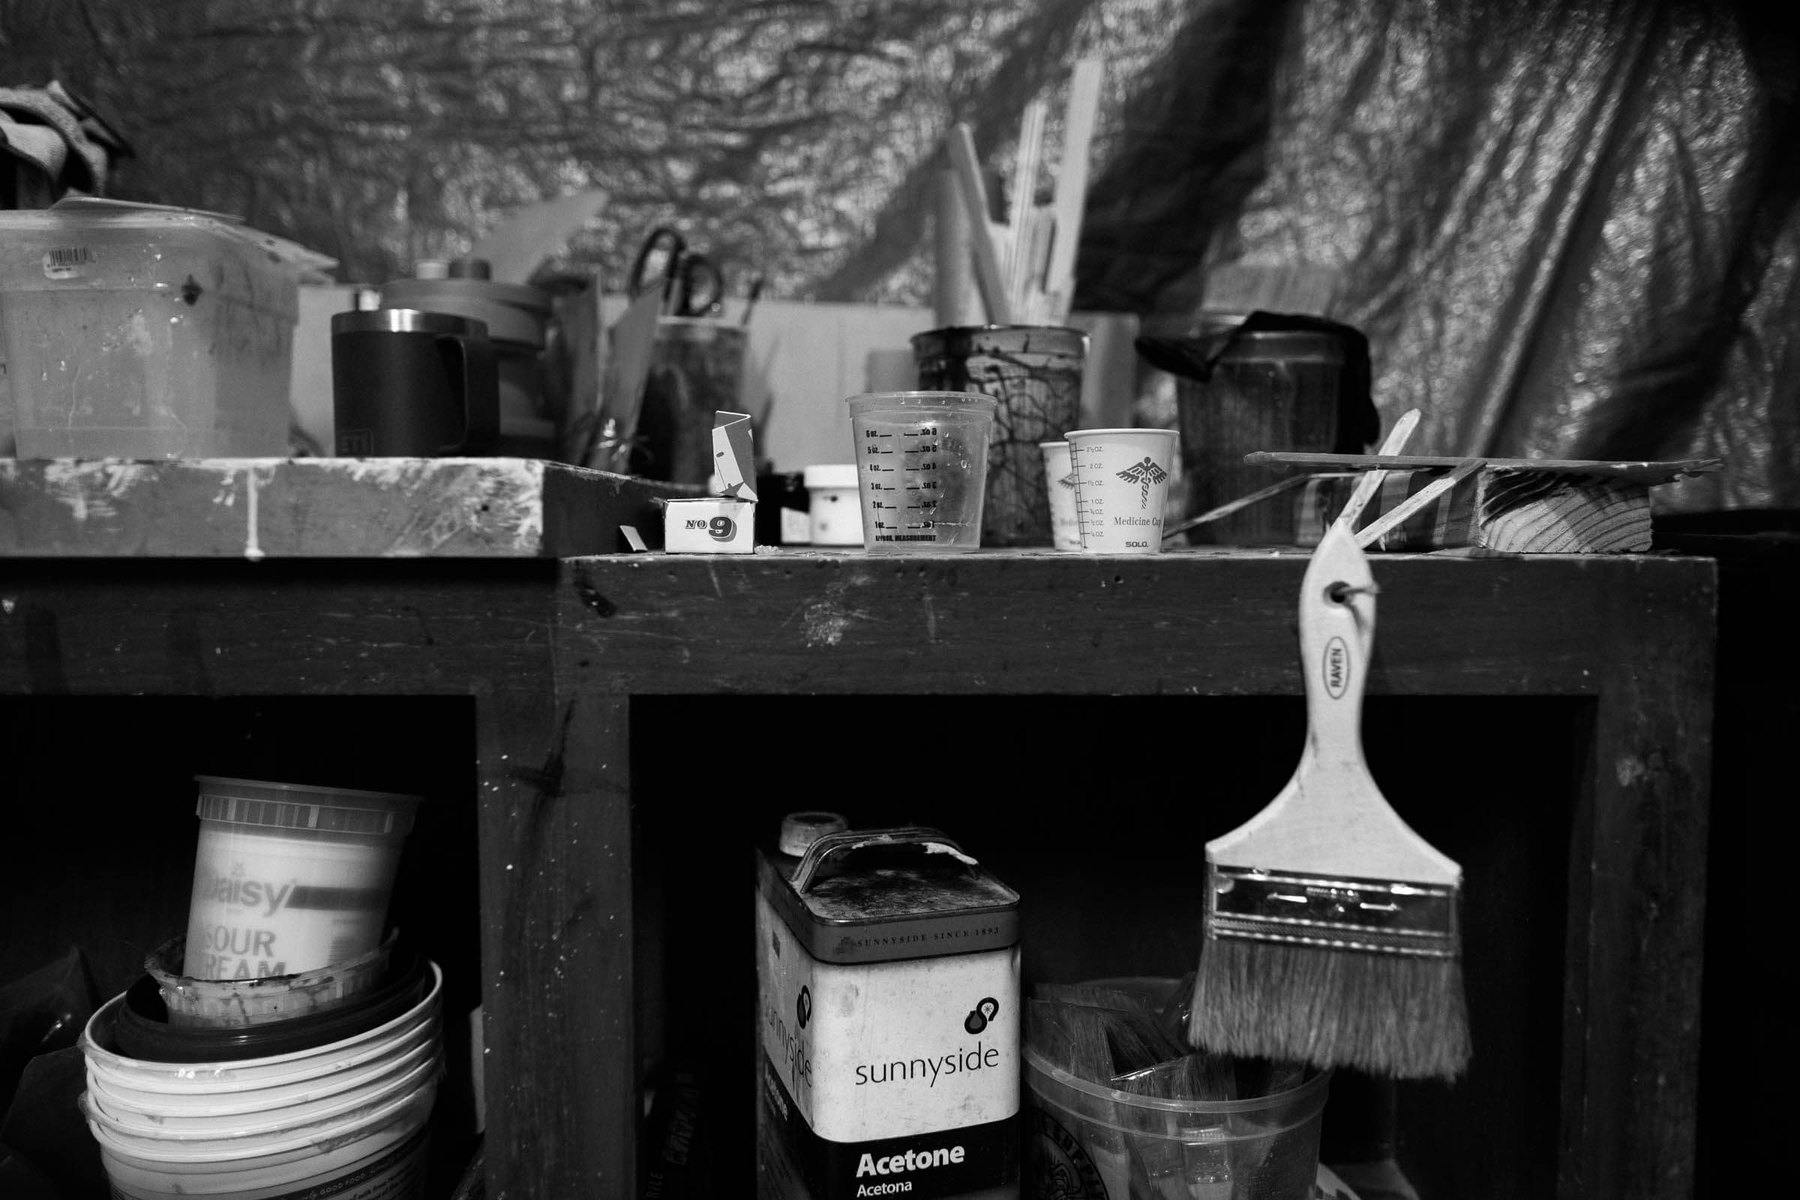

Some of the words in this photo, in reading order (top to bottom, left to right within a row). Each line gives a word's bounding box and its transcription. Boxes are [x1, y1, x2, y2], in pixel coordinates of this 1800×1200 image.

[709, 516, 738, 543] 9
[1114, 517, 1151, 527] Medicine
[1330, 648, 1342, 688] RAVEN
[857, 933, 927, 947] SUNNYSIDE
[934, 930, 970, 941] SINCE
[855, 1041, 1000, 1088] sunnyside
[856, 1145, 966, 1178] Acetone
[856, 1181, 912, 1198] Acetona
